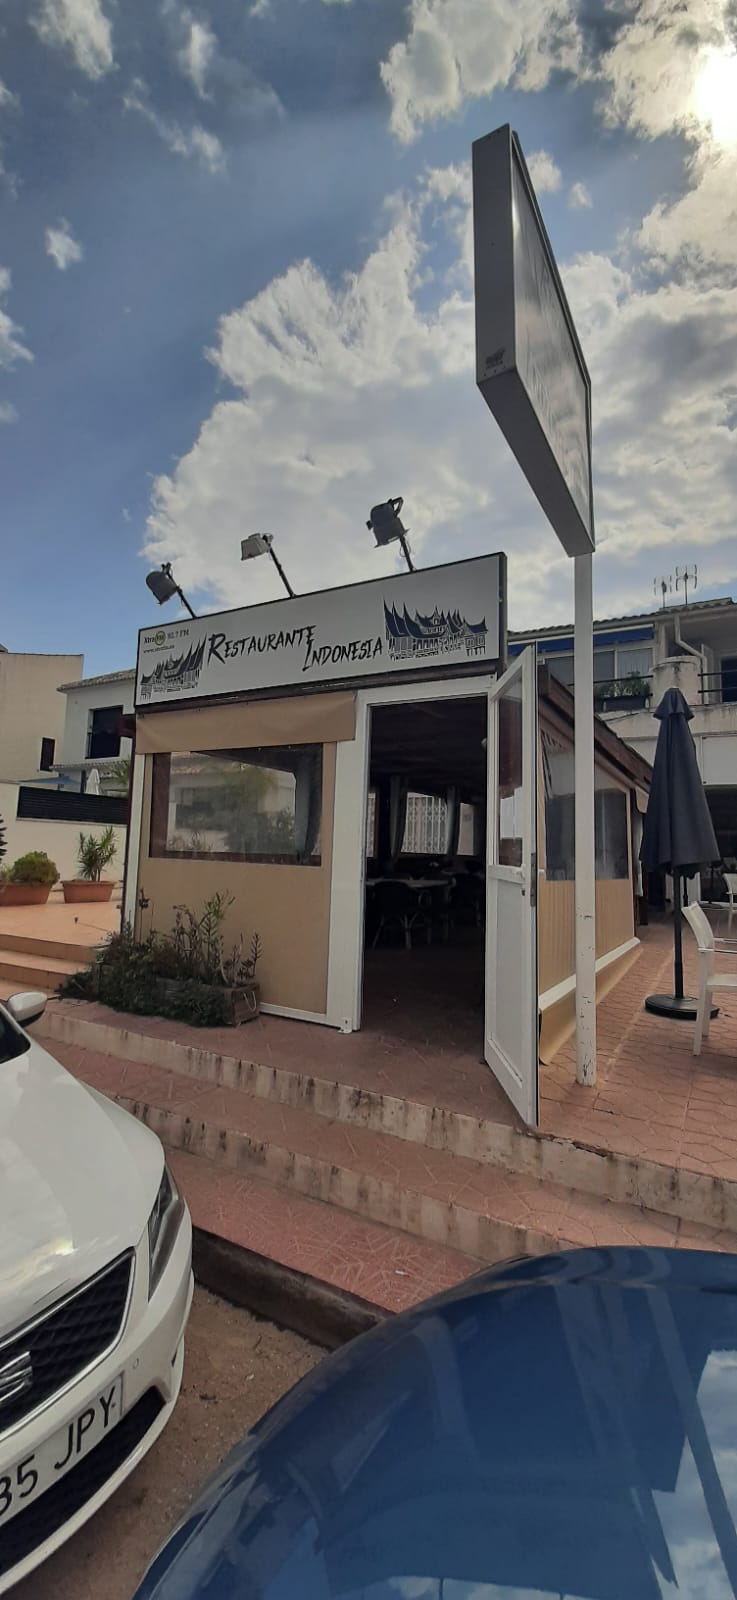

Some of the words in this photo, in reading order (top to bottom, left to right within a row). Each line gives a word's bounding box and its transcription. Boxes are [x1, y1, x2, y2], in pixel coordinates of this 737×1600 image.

[207, 624, 316, 665] RESTAURANTE
[302, 637, 383, 672] INDONESIA
[54, 1386, 116, 1470] JPY
